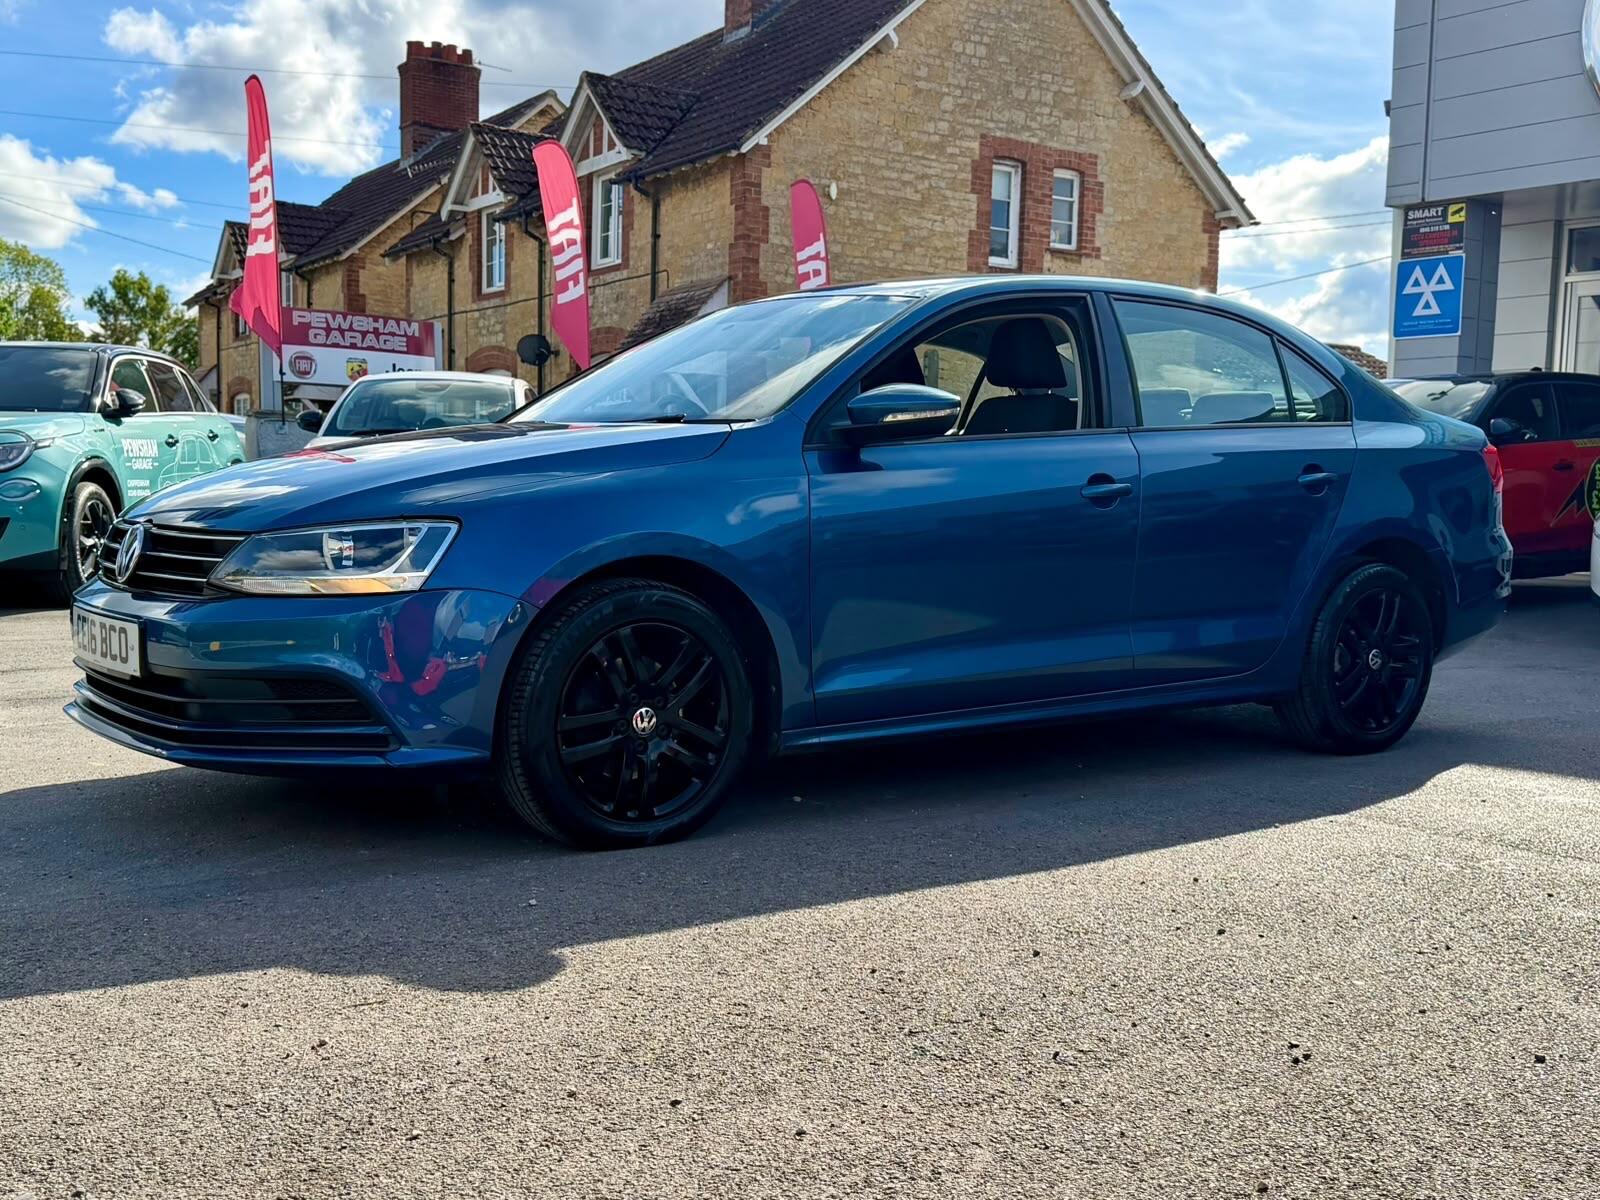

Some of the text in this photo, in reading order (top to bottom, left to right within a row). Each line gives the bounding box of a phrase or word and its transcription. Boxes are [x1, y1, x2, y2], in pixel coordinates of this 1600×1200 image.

[1407, 207, 1444, 220] SMART
[292, 310, 419, 337] PEWSHAM
[308, 328, 408, 351] GARAGE
[295, 359, 313, 372] FIAT
[121, 438, 159, 458] PEWSHAM
[131, 458, 153, 470] GARAGE
[99, 621, 129, 664] BCO
